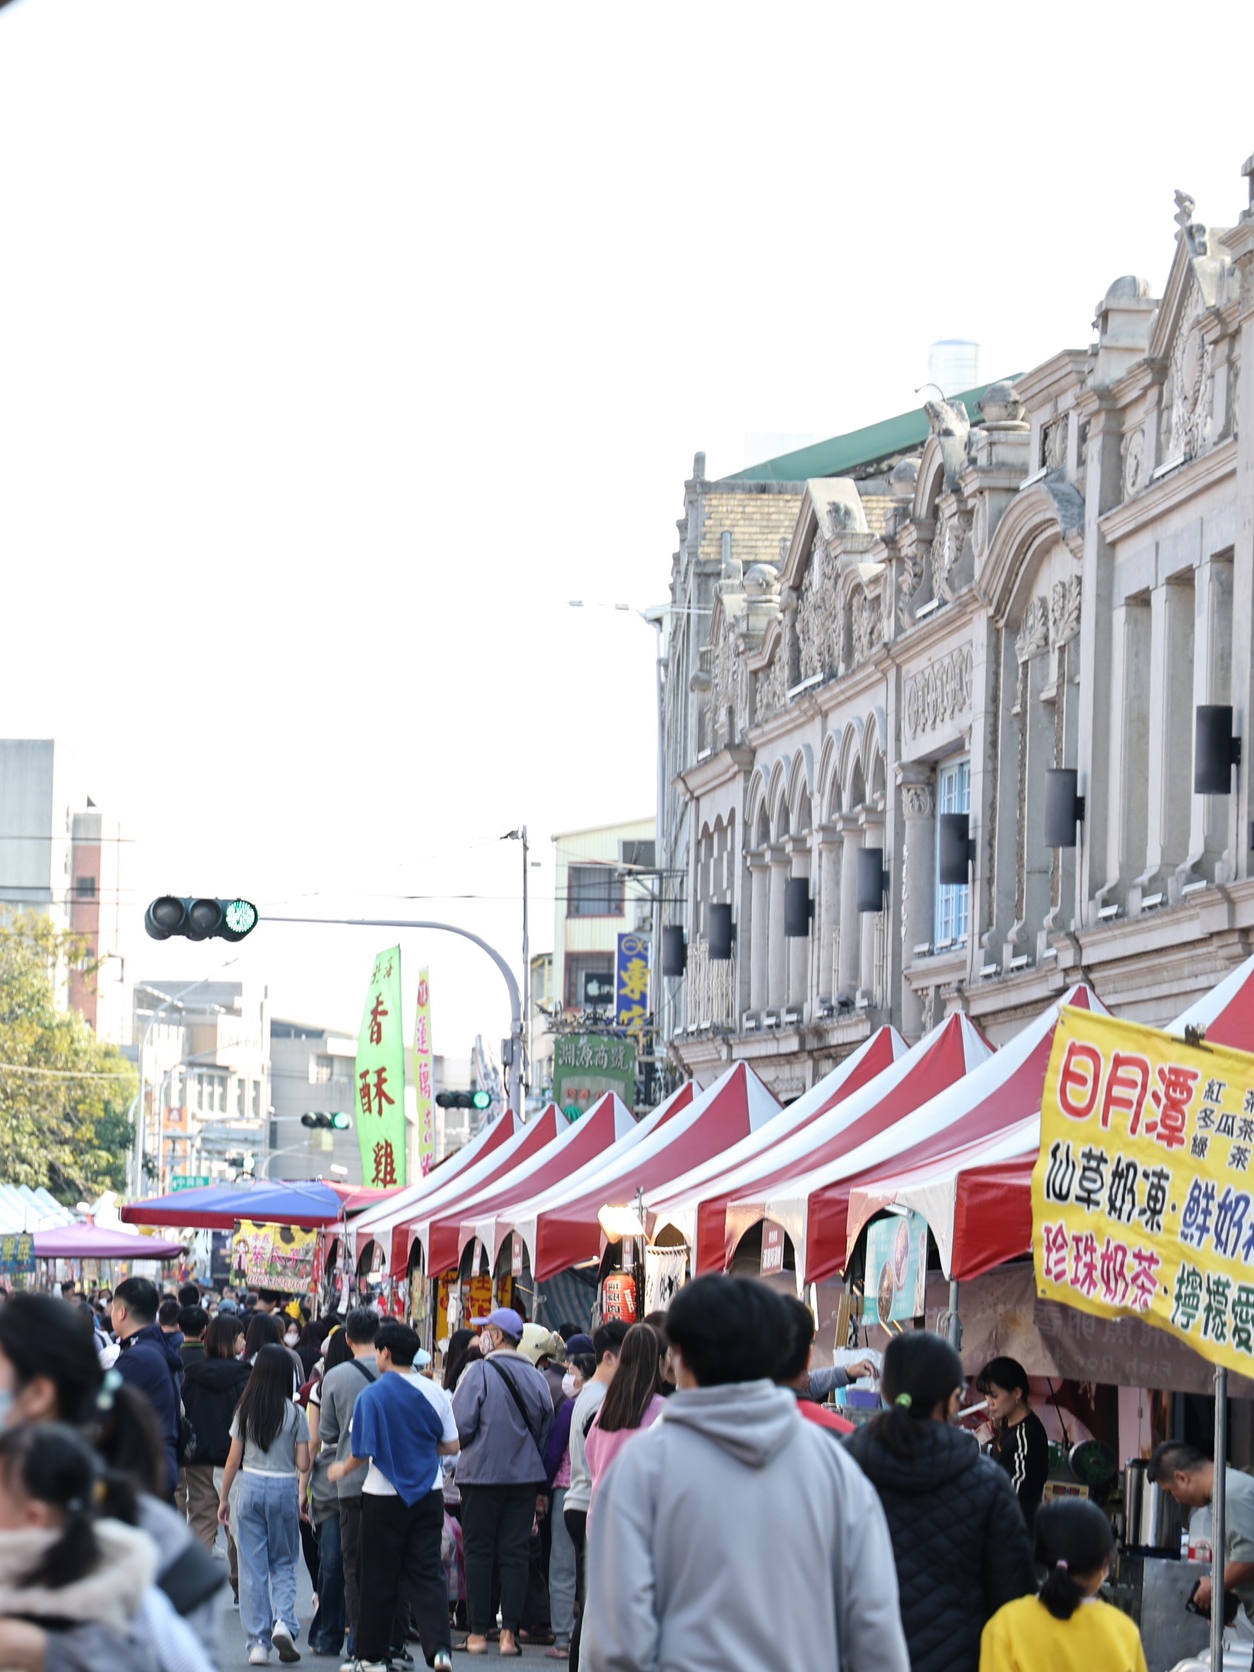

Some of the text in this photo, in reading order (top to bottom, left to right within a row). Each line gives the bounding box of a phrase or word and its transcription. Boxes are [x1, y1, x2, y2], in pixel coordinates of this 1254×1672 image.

[358, 992, 397, 1188] 香酥雞
[1059, 1041, 1199, 1149] 日月潭
[1044, 1223, 1160, 1311] 珍珠奶茶
